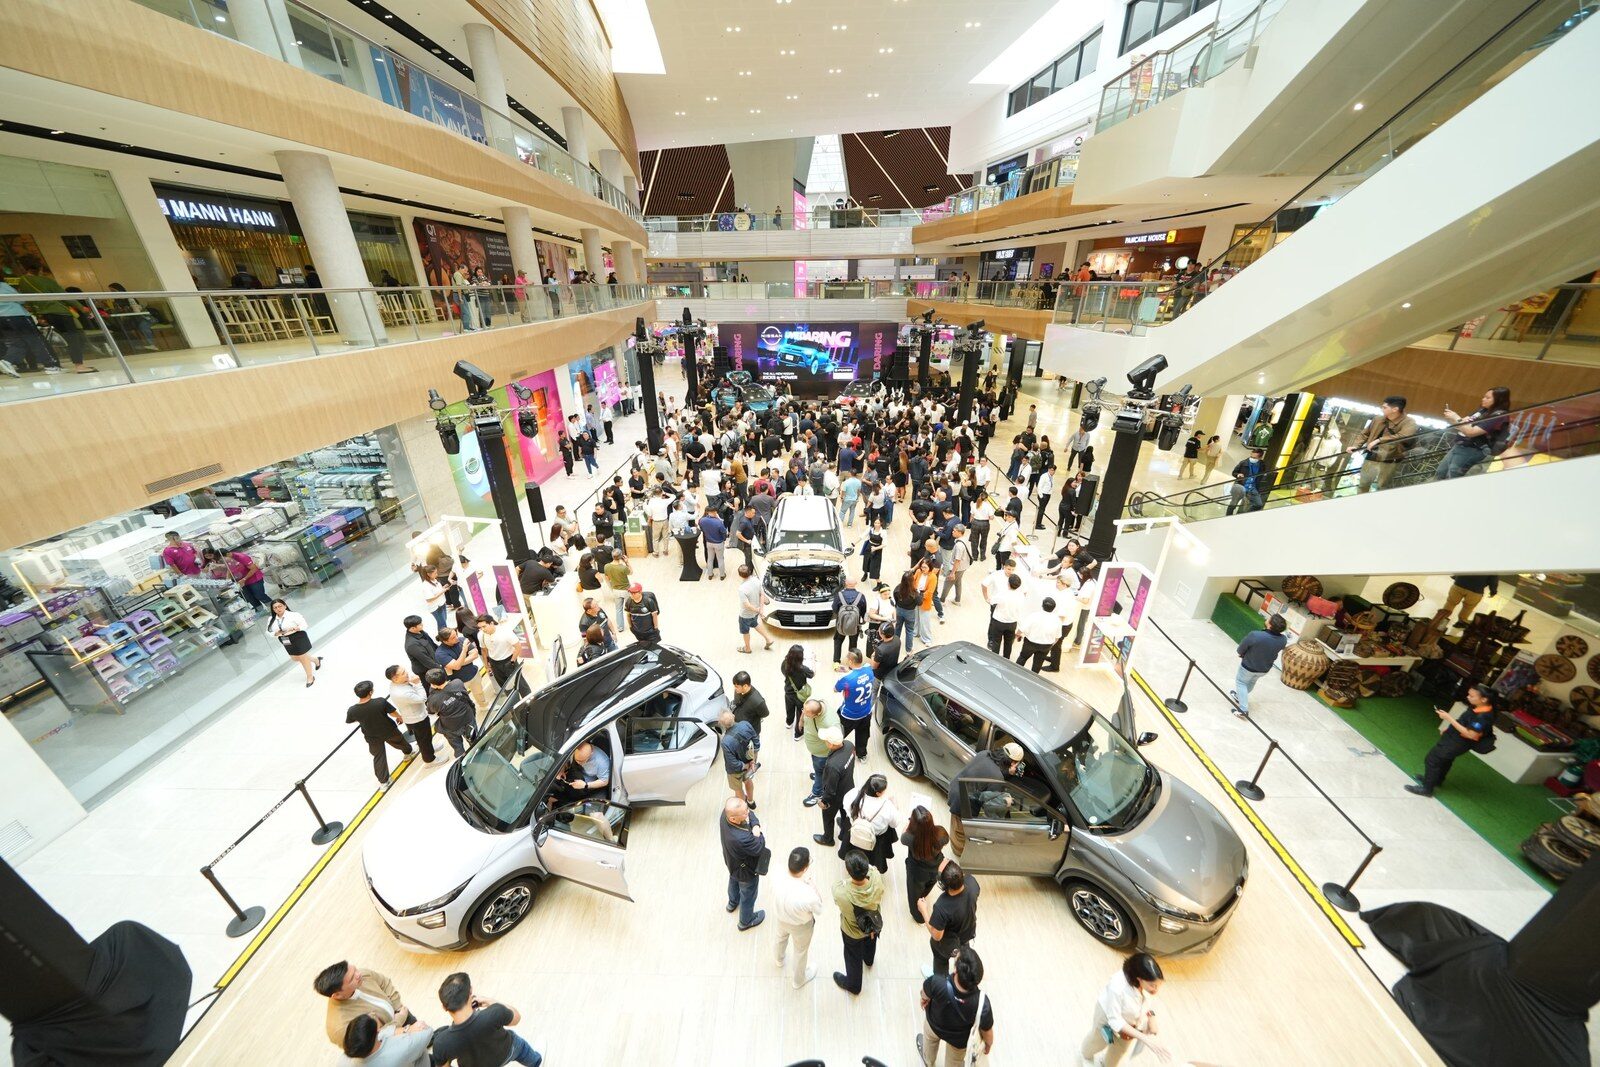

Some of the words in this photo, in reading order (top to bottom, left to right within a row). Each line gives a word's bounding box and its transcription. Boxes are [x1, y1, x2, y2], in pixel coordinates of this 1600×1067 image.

[169, 199, 228, 222] MANN
[228, 206, 276, 227] HANN
[1125, 236, 1147, 244] PANCAKE
[1148, 233, 1166, 241] HOUSE
[734, 334, 742, 371] DARING
[873, 332, 882, 370] DARING
[855, 682, 873, 703] 23
[262, 800, 284, 821] NISSAN
[209, 843, 236, 868] NISSAN
